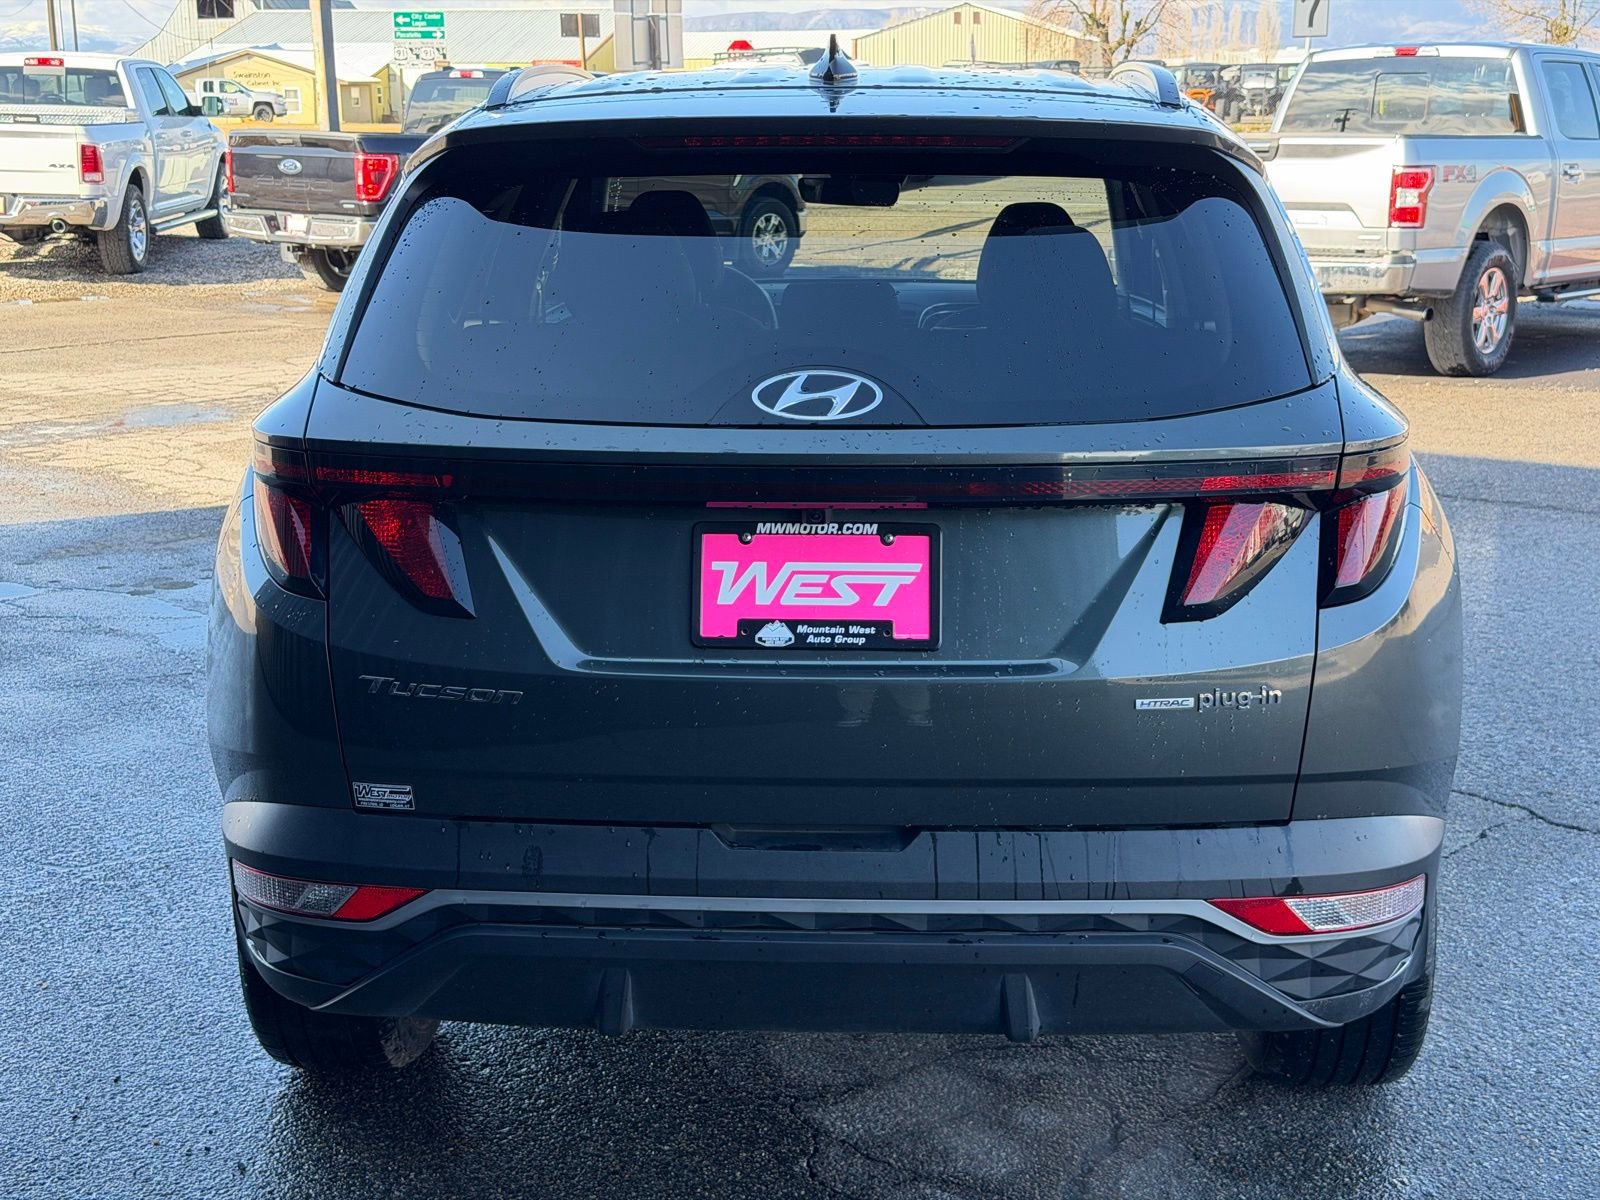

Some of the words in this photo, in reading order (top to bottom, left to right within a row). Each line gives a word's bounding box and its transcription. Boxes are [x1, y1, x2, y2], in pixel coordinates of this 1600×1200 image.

[756, 523, 879, 536] MWMOTOR.COM
[711, 561, 923, 607] WEST
[796, 624, 846, 634] Mountain
[848, 625, 877, 634] West
[806, 634, 832, 643] Auto
[834, 634, 867, 645] Group
[1138, 698, 1192, 709] HTRAC
[1198, 685, 1283, 713] plug-in
